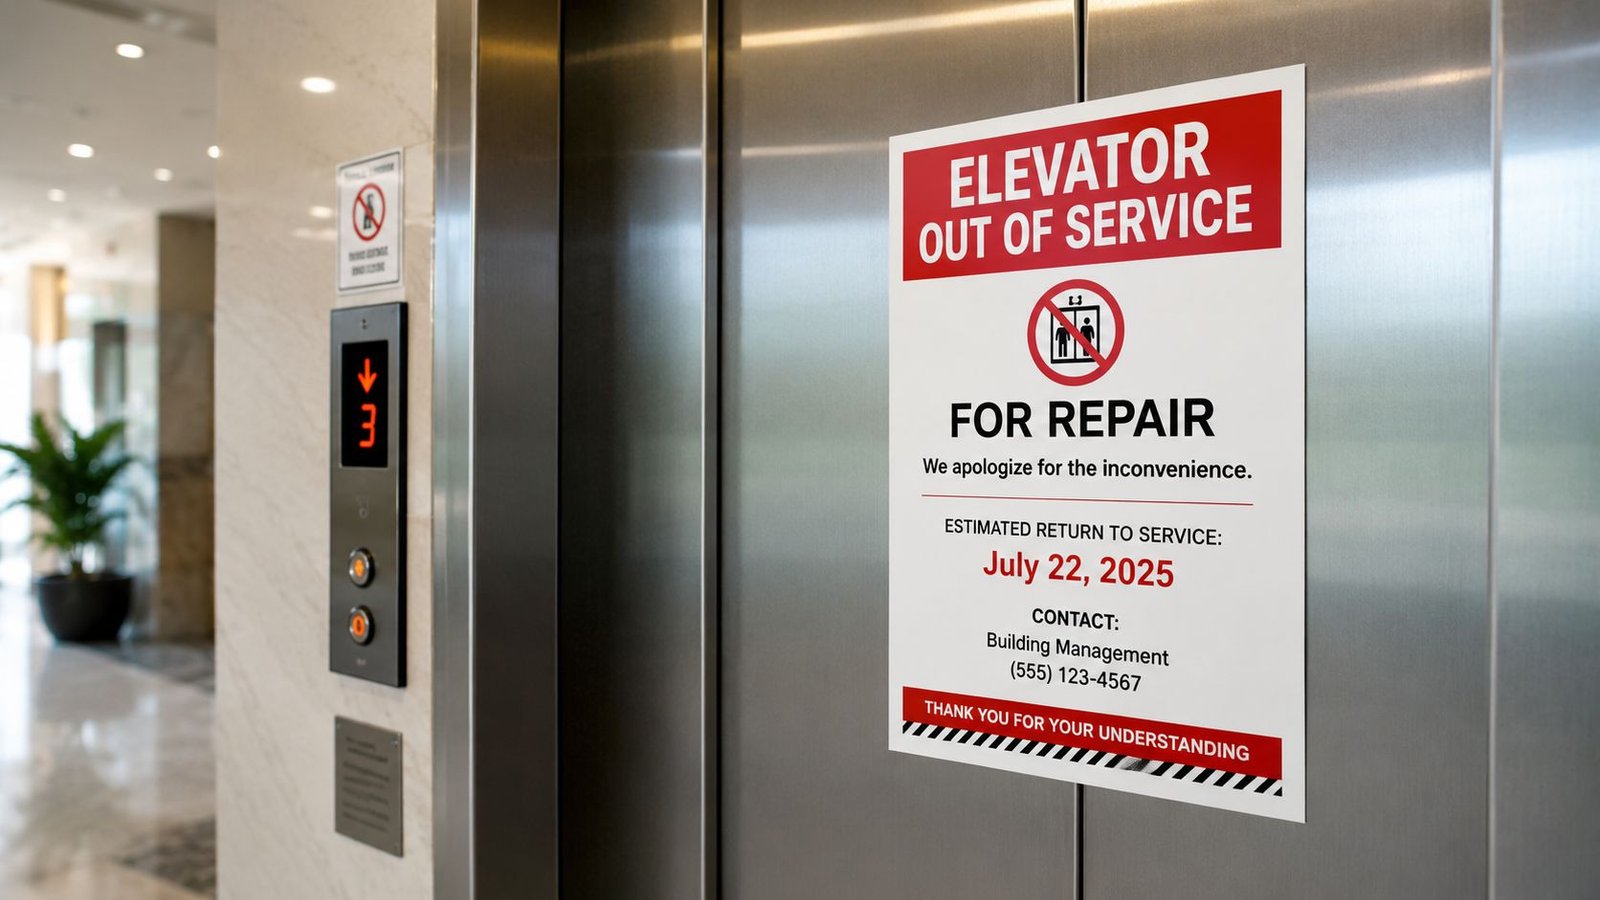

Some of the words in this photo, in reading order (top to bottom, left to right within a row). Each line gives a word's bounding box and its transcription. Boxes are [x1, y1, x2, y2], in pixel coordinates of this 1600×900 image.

[950, 121, 1211, 208] ELEVATOR
[919, 216, 992, 264] OUT
[1003, 208, 1053, 256] OF
[1065, 184, 1253, 249] SERVICE
[359, 404, 377, 447] 3
[951, 402, 1032, 438] FOR
[1049, 398, 1215, 437] REPAIR
[923, 458, 947, 474] We
[952, 459, 1032, 479] apologize
[1037, 459, 1062, 476] for
[1068, 459, 1097, 477] the
[1103, 459, 1253, 479] inconvenience.
[945, 519, 1031, 537] ESTIMATED
[1036, 521, 1104, 540] RETURN
[1109, 525, 1133, 542] TO
[1139, 526, 1222, 546] SERVICE:
[983, 551, 1039, 585] July
[1048, 553, 1090, 587] 22,
[1100, 556, 1174, 588] 2025
[1032, 608, 1119, 631] CONTACT:
[987, 632, 1050, 657] Building
[1056, 639, 1169, 666] Management
[1010, 660, 1053, 685] (555)
[1058, 667, 1142, 692] 123-4567
[924, 700, 974, 720] THANK
[977, 707, 1009, 726] YOU
[1014, 712, 1044, 732] FOR
[1049, 717, 1094, 739] YOUR
[1099, 725, 1251, 762] UNDERSTANDING
